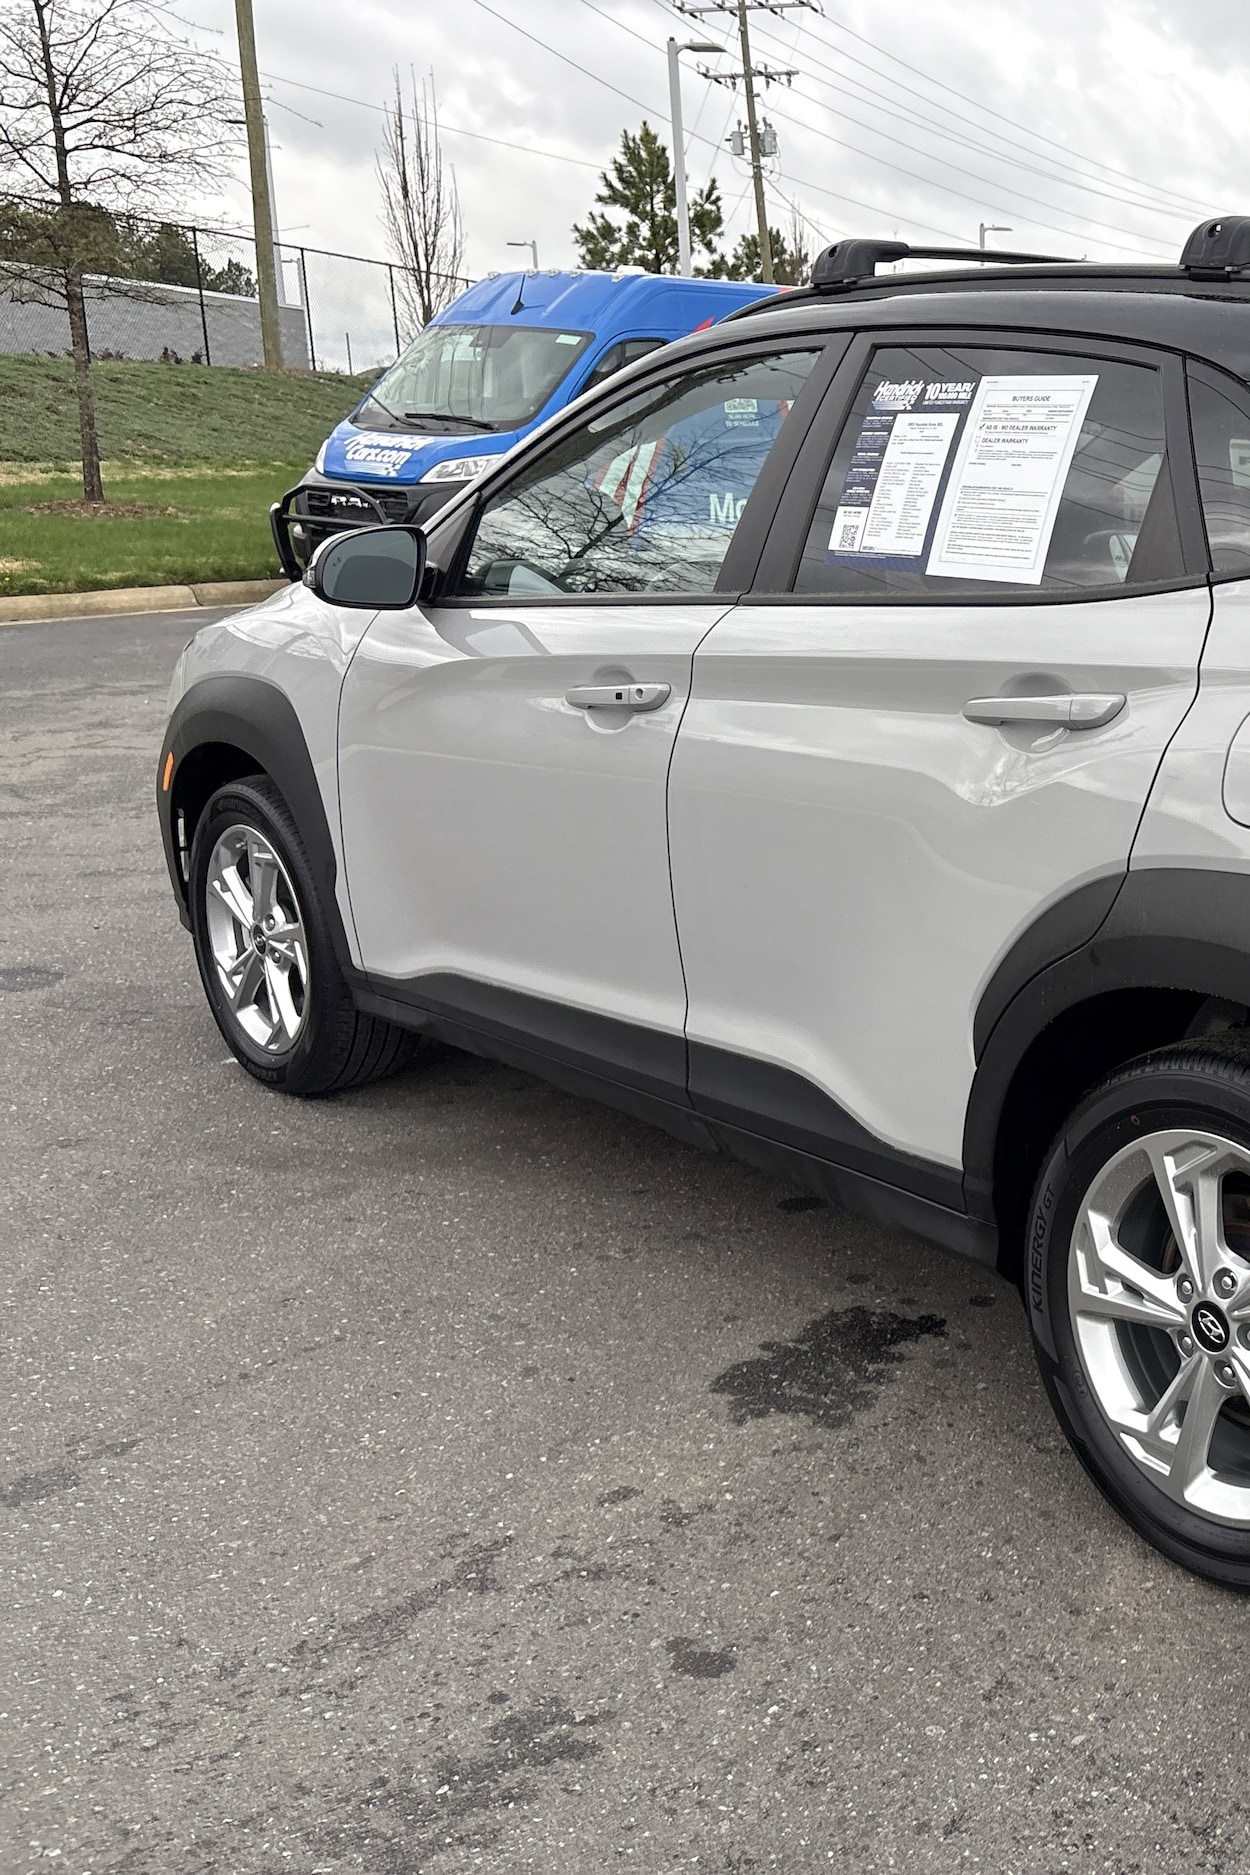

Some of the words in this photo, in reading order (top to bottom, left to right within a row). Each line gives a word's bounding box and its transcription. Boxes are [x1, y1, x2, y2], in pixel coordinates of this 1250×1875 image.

[874, 380, 925, 400] Hendrick
[924, 382, 942, 401] 10
[346, 444, 413, 465] Cars.com
[1032, 1207, 1047, 1314] KINERGY
[1043, 1182, 1055, 1210] GT
